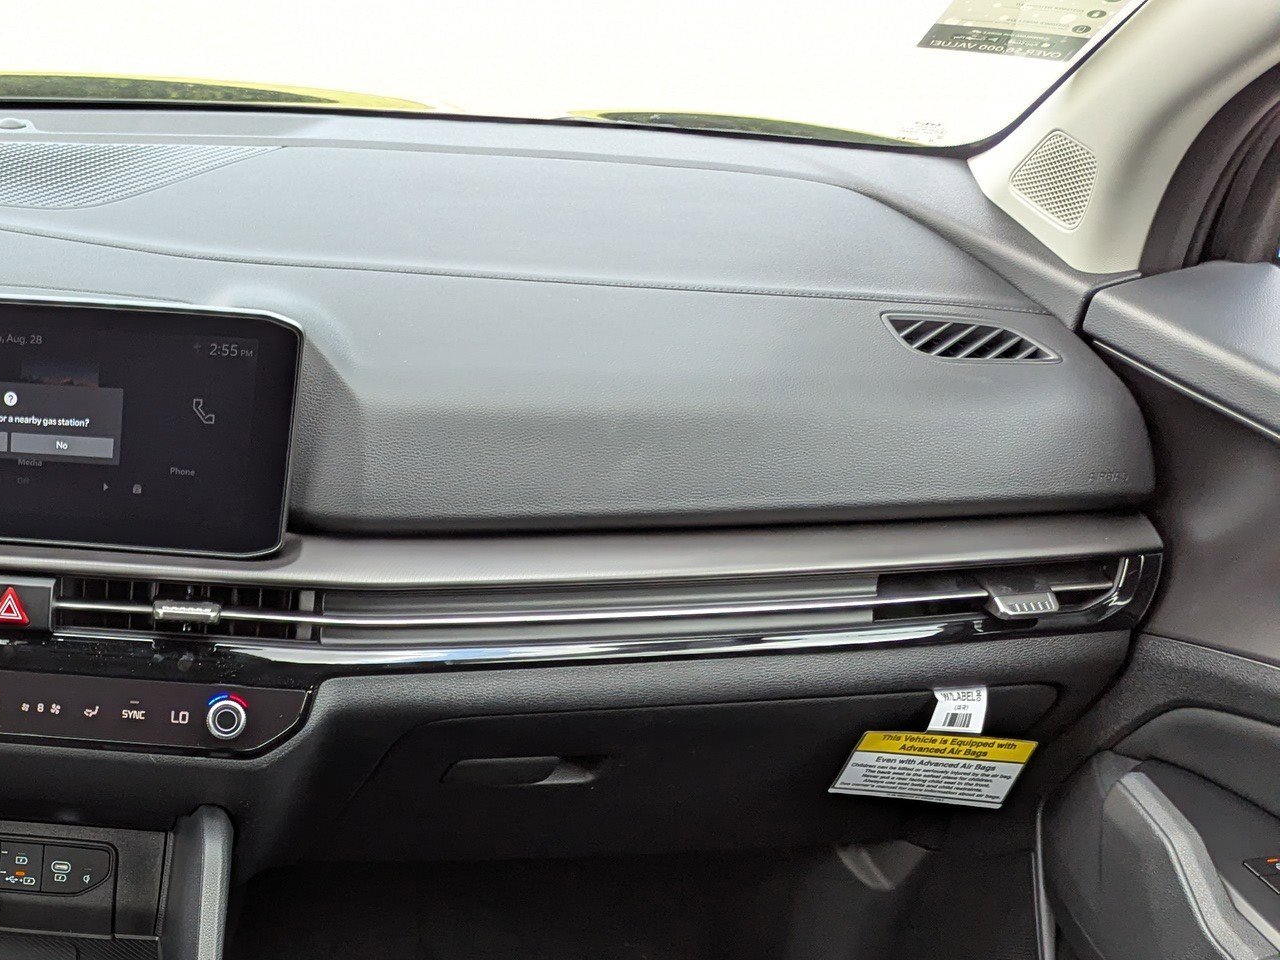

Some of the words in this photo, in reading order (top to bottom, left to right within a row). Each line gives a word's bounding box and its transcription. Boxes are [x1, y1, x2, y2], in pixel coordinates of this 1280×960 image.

[6, 334, 27, 345] Aug.
[30, 335, 42, 344] 28
[210, 343, 238, 356] 2:55
[15, 415, 41, 426] nearby
[43, 418, 56, 427] gas
[57, 418, 89, 427] station?
[56, 441, 68, 450] No
[170, 467, 195, 476] Phone
[37, 704, 44, 712] 8
[122, 710, 146, 720] SYNC
[171, 711, 189, 724] LO
[905, 735, 937, 744] Vehicle
[950, 738, 995, 748] Equipped
[899, 744, 946, 754] Advanced
[964, 749, 988, 757] Bags
[917, 759, 960, 768] Advanced
[974, 764, 996, 772] Bags
